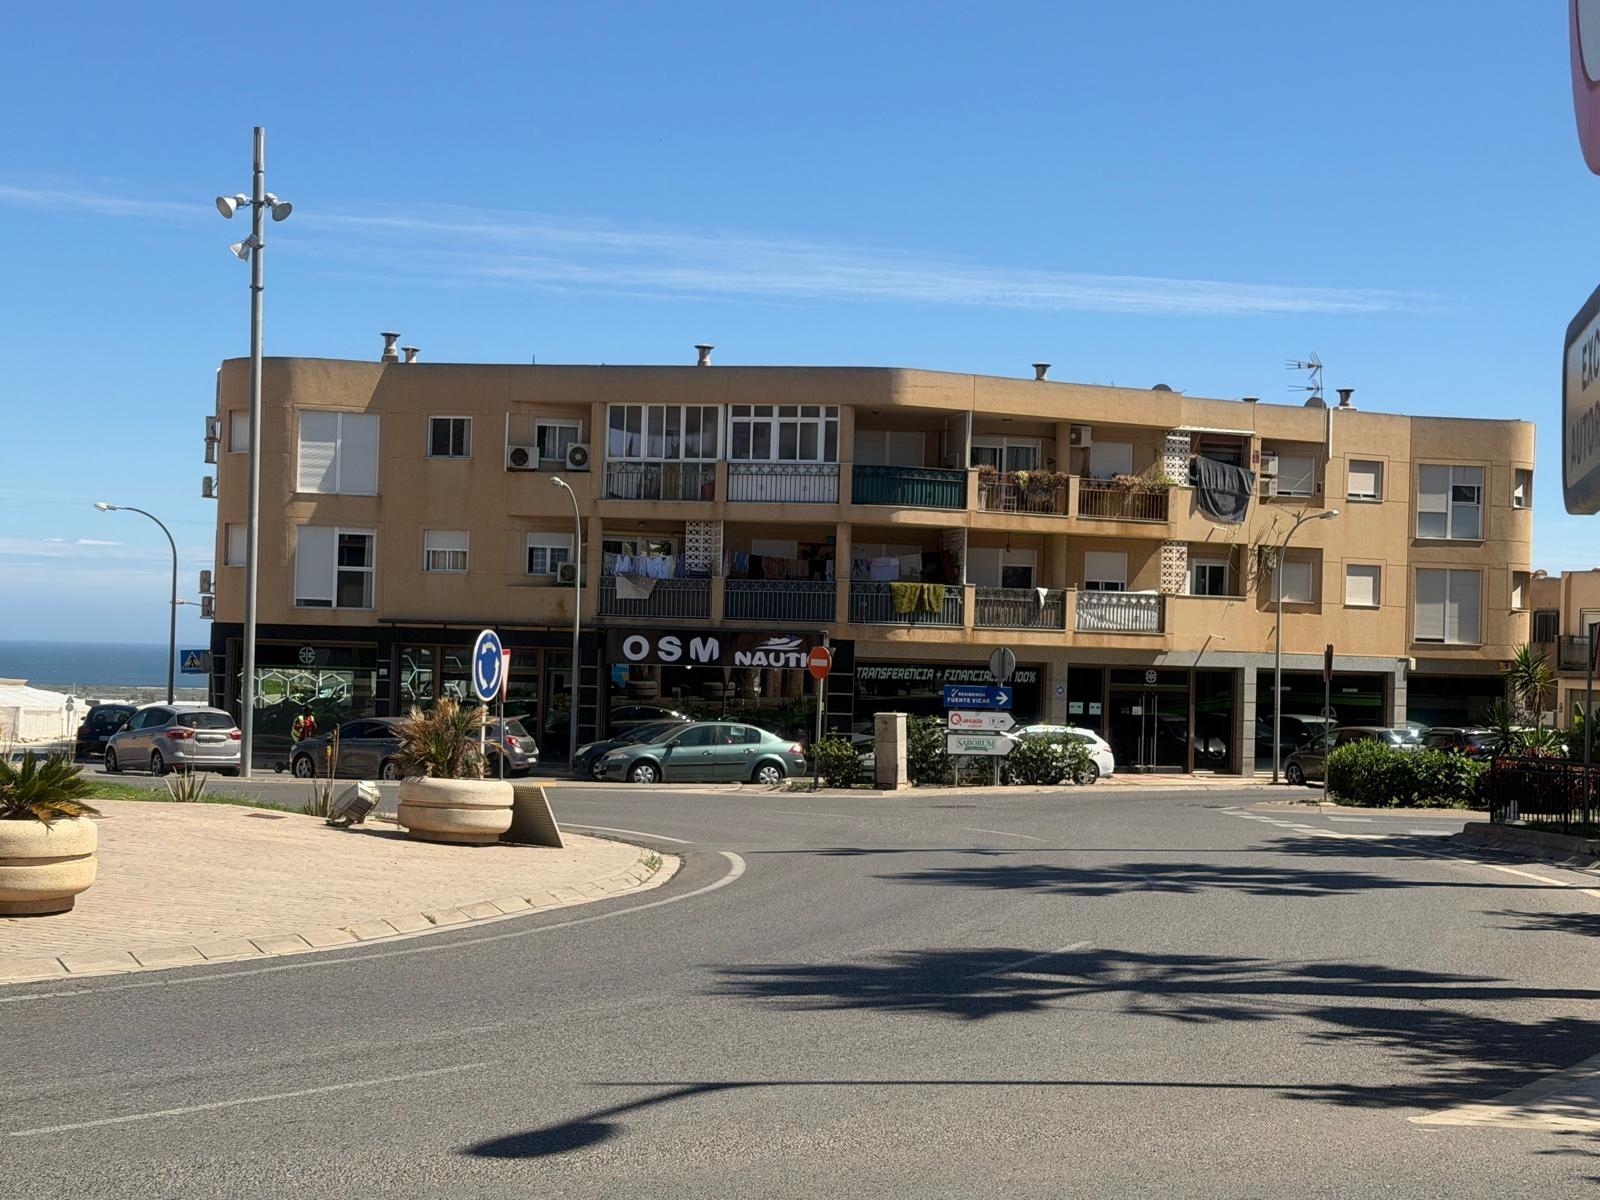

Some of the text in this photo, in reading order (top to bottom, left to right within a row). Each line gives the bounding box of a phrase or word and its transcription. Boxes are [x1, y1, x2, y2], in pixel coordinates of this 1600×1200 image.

[623, 635, 719, 662] OSM
[735, 651, 808, 667] NAUTI
[857, 667, 934, 681] TRANSFERENCIA
[1014, 671, 1036, 683] 100%
[950, 713, 983, 726] Quesada
